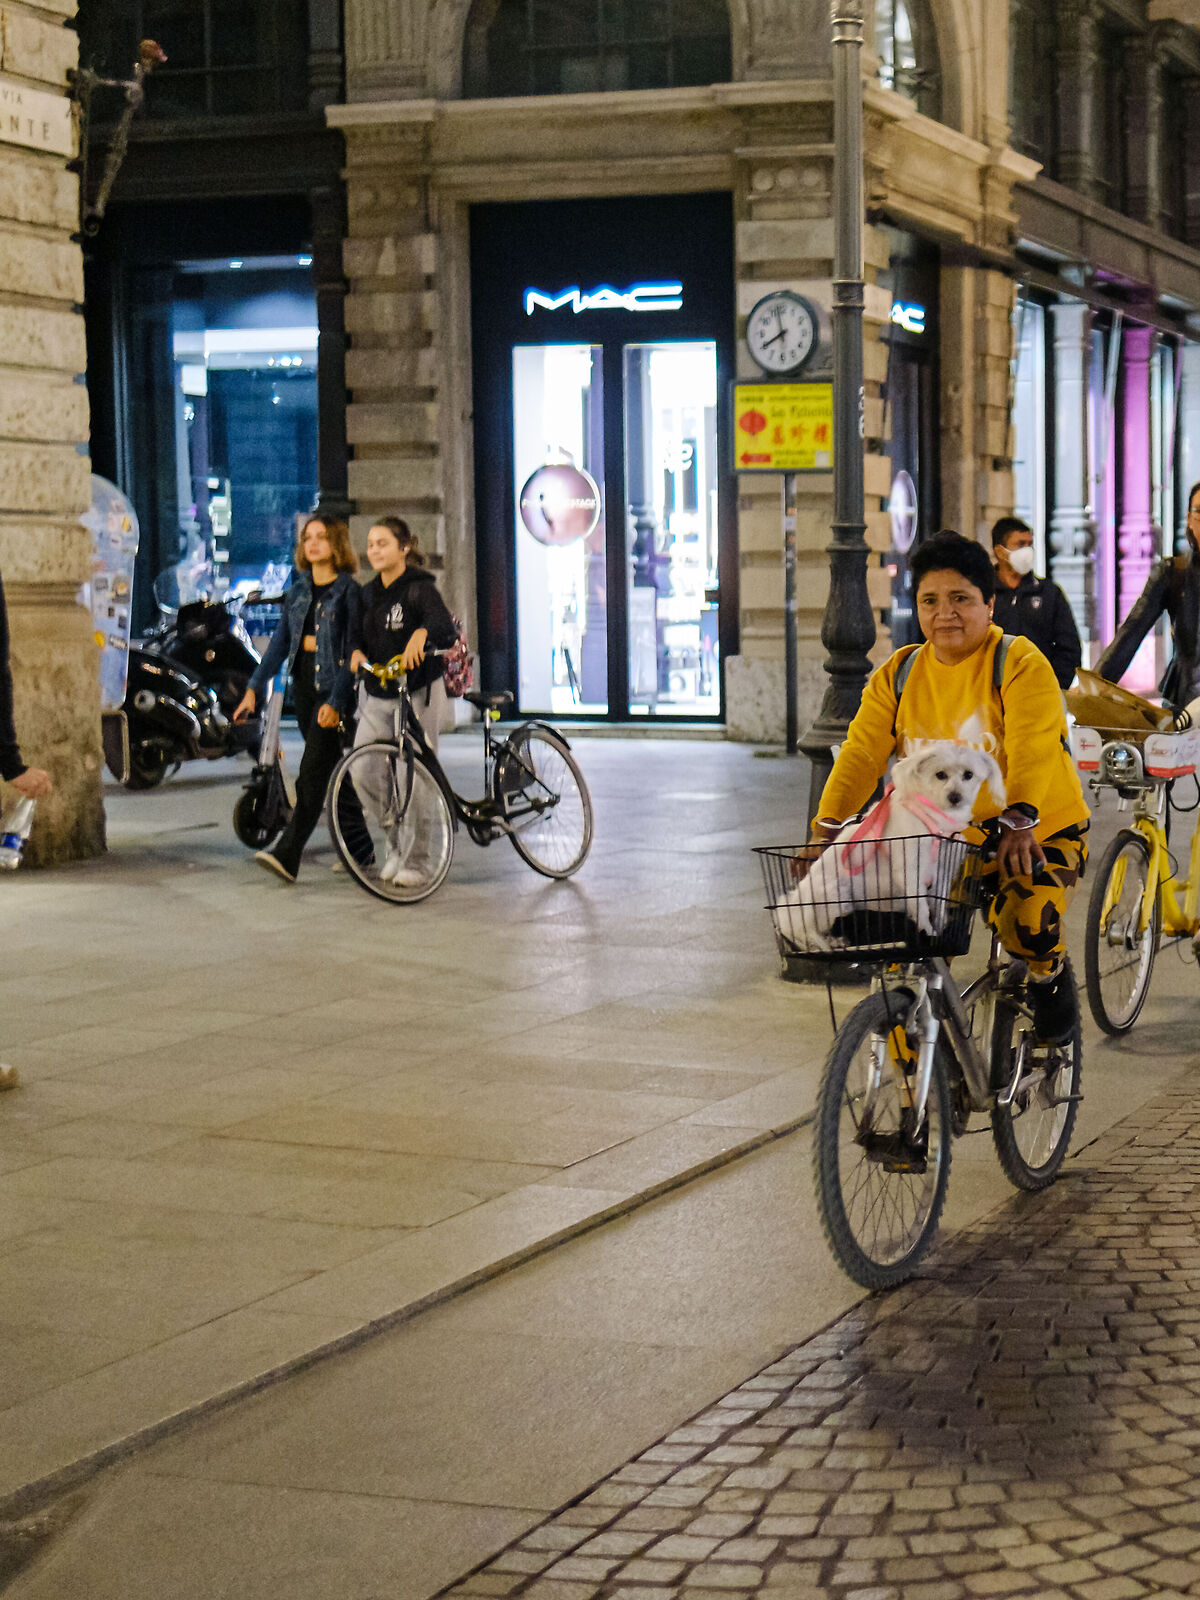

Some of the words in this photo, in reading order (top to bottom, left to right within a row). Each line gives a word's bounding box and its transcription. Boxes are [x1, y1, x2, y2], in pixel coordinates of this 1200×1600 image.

[2, 89, 22, 104] VIA
[0, 115, 50, 141] NTE
[524, 283, 683, 316] MAC
[890, 301, 925, 333] AC
